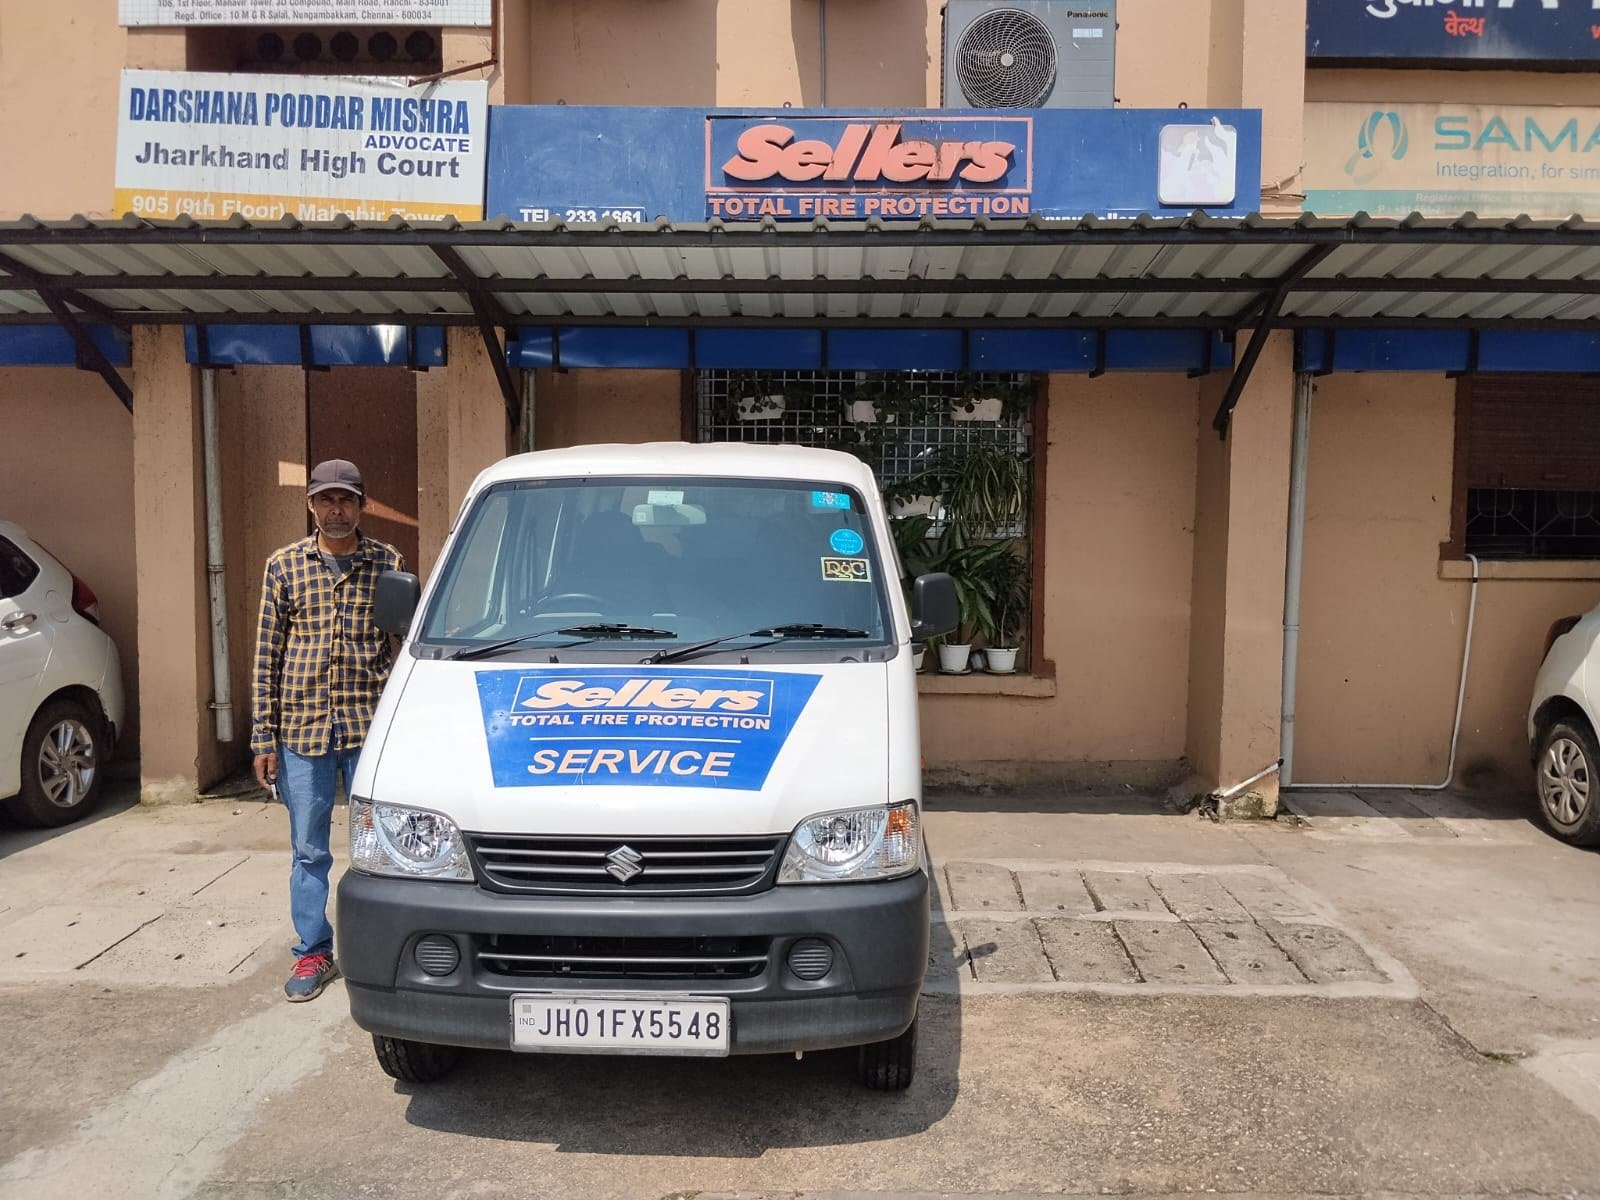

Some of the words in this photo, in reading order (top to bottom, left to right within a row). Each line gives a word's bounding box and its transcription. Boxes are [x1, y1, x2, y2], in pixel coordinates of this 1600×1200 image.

[200, 10, 222, 20] Office
[230, 11, 239, 19] 10
[241, 11, 249, 19] M
[260, 11, 266, 19] R
[361, 10, 394, 19] Chennai
[1444, 10, 1486, 37] वेल्थ
[130, 88, 258, 126] DARSHANA
[265, 92, 364, 131] PODDAR
[370, 97, 470, 135] MISHRA
[364, 134, 470, 153] ADVOCATE
[721, 124, 1017, 183] Sellers
[135, 143, 289, 171] Jharkhand
[300, 149, 366, 179] High
[377, 153, 460, 178] Court
[1436, 161, 1536, 181] Integration,
[1541, 162, 1565, 178] for
[132, 195, 169, 214] 905
[175, 197, 215, 217] (9th
[566, 209, 597, 223] 233
[708, 197, 791, 216] TOTAL
[799, 197, 856, 216] FIRE
[863, 197, 1029, 216] PROTECTION
[520, 679, 766, 711] Sellers
[510, 714, 575, 727] TOTAL
[581, 714, 629, 726] FIRE
[634, 714, 771, 731] PROTECTION
[527, 749, 736, 777] SERVICE
[519, 1017, 536, 1026] IND
[538, 1008, 720, 1040] JH01FX5548
